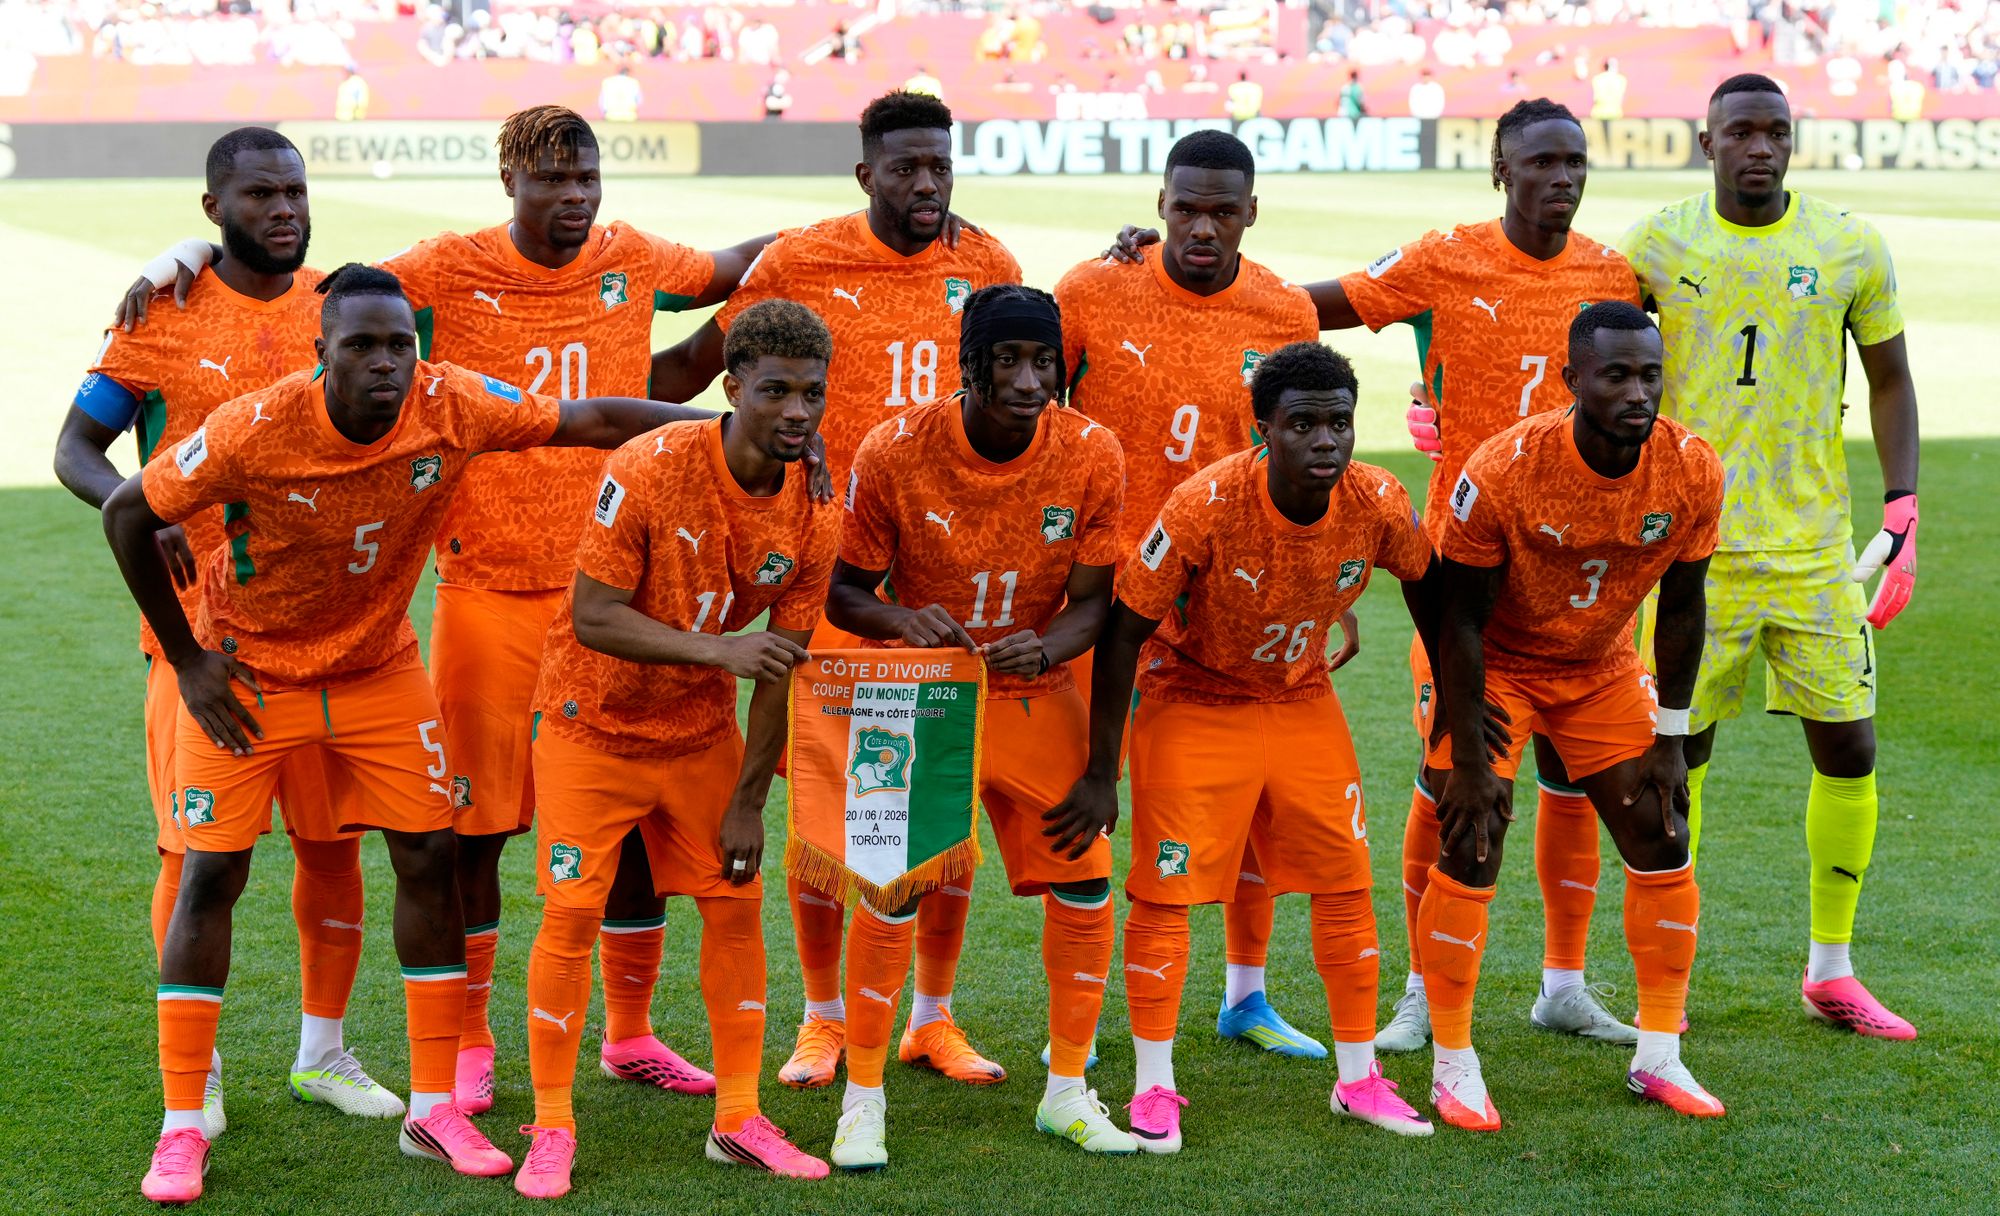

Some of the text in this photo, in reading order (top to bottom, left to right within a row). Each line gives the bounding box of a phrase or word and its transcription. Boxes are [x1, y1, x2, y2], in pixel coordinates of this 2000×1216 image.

[1109, 119, 1232, 173] TH
[1237, 117, 1422, 172] GAME
[1435, 118, 1693, 169] RARD
[525, 342, 587, 400] 20
[885, 340, 938, 407] 18
[1736, 325, 1758, 386] 1
[1518, 355, 1549, 416] 7
[1164, 404, 1200, 462] 9
[347, 521, 385, 575] 5
[964, 570, 1019, 628] 11
[1569, 559, 1608, 609] 3
[1251, 620, 1316, 663] 26
[1859, 624, 1872, 675] 1
[812, 682, 958, 701] COUPE DU MONDE 2026
[820, 659, 953, 679] CÔTE D'IVOIRE
[821, 705, 873, 718] ALLEMAGNE
[875, 710, 885, 719] vs
[886, 707, 909, 719] CÔTE
[417, 719, 447, 779] 5
[845, 810, 908, 822] 20 / 06 / 2026
[851, 835, 902, 847] TORONTO
[872, 823, 880, 833] A
